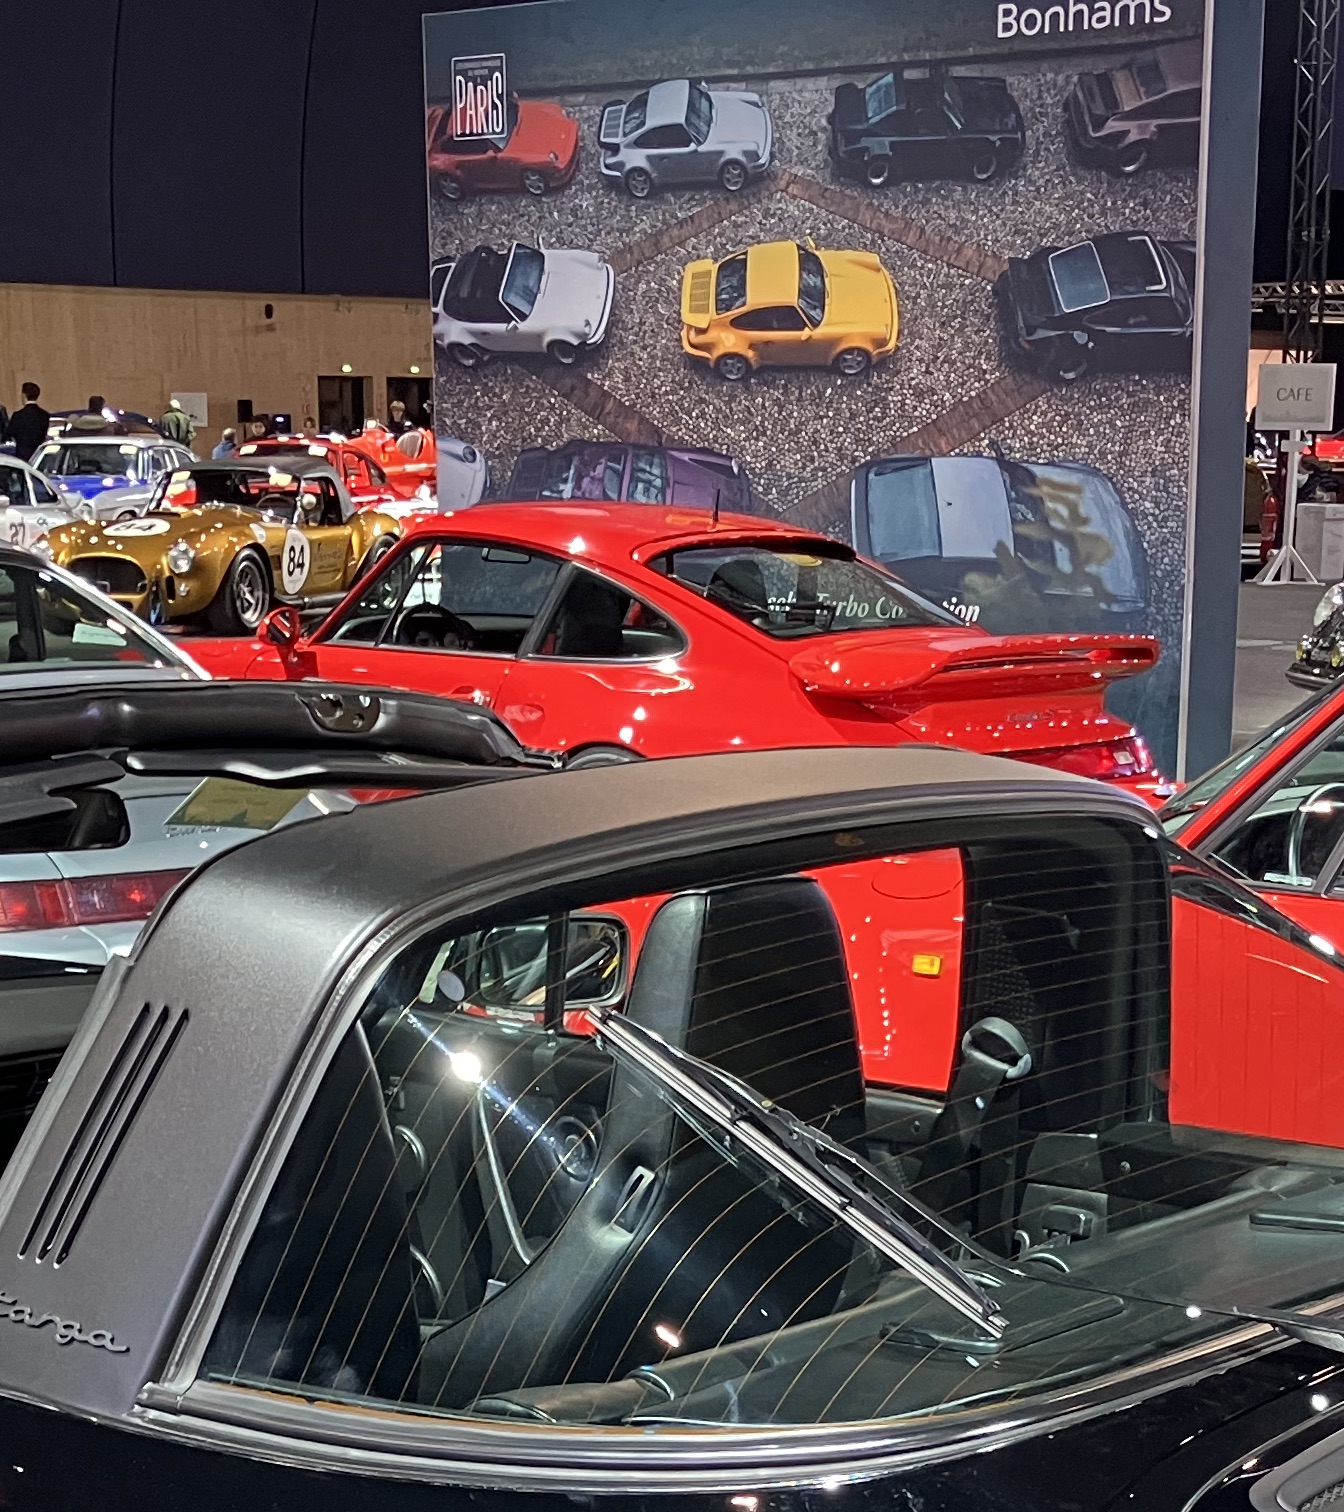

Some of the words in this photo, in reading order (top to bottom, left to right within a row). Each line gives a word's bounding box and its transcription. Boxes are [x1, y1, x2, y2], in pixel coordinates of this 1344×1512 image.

[997, 0, 1172, 38] Bonhams
[455, 71, 503, 135] PARIS
[1276, 387, 1314, 402] CAFE
[287, 544, 306, 577] 84
